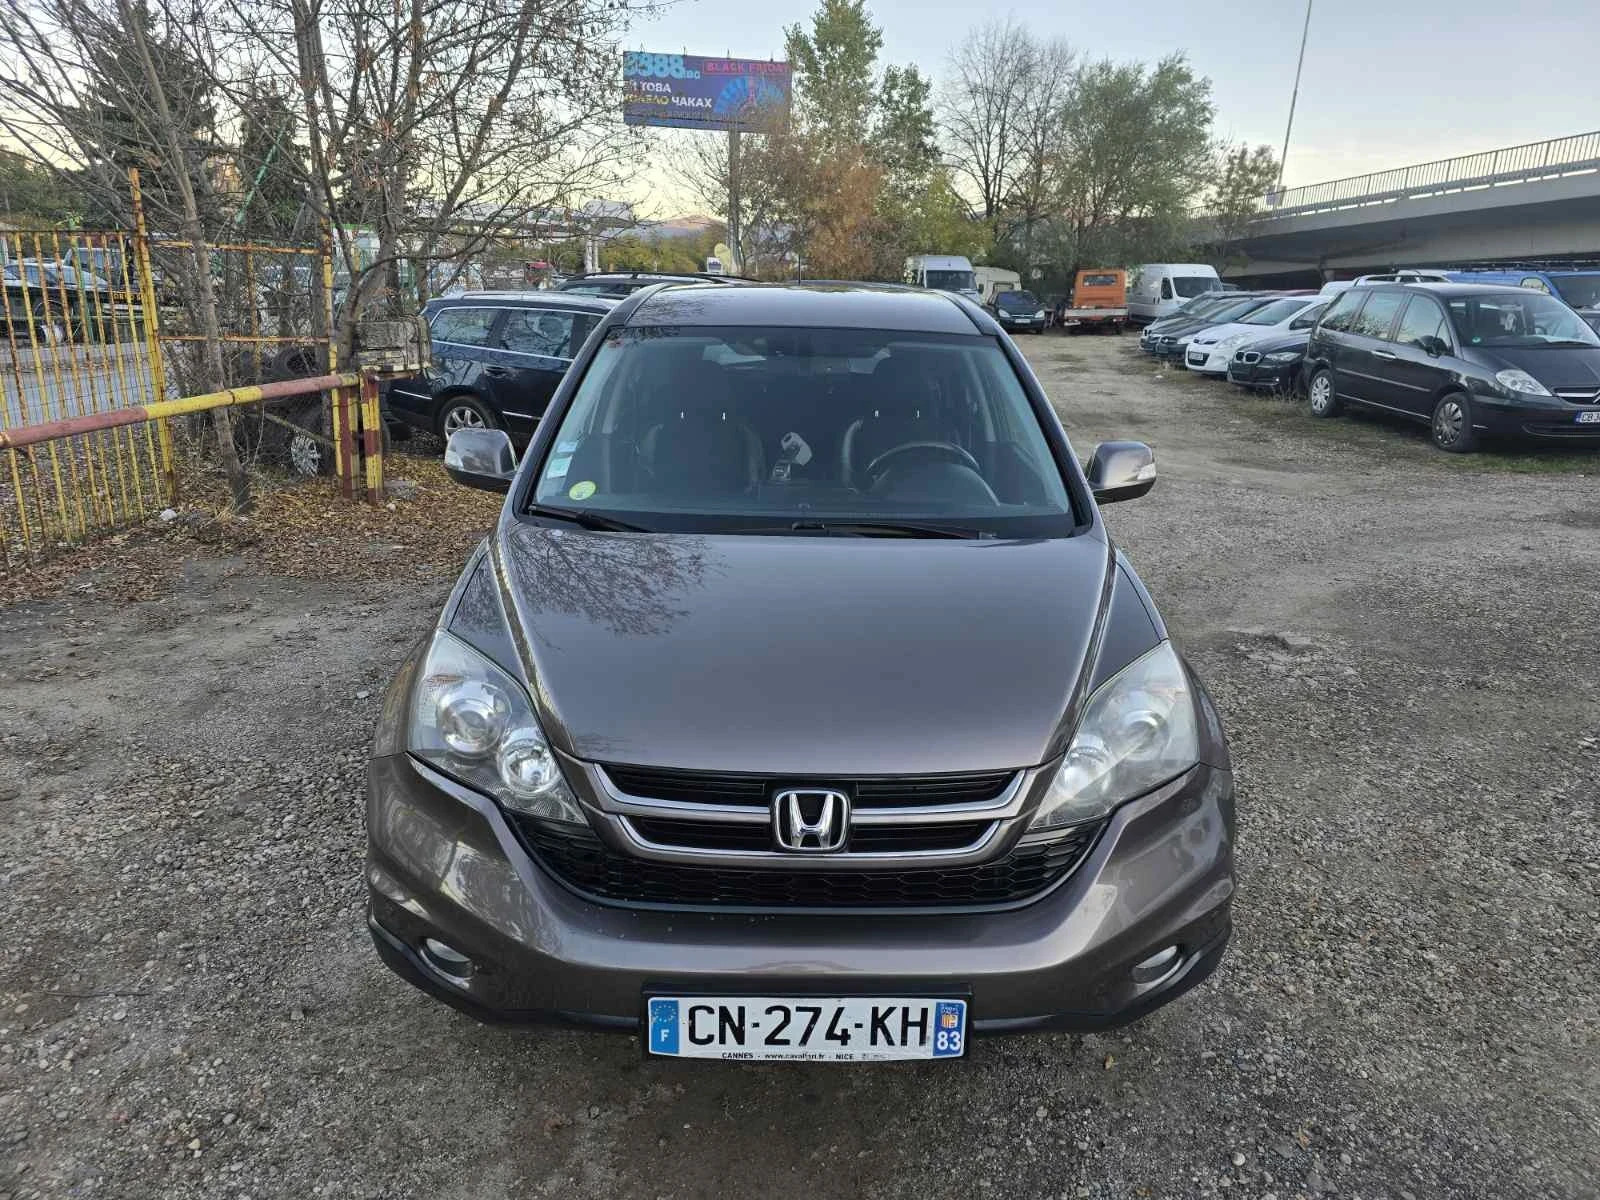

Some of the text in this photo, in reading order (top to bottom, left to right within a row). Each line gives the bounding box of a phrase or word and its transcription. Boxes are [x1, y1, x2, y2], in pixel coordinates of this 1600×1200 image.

[707, 62, 745, 73] BLACK
[641, 81, 672, 93] ТОВА
[671, 96, 712, 108] ЧАКАХ
[688, 1005, 929, 1047] CN-274-KH
[660, 1029, 668, 1042] F
[936, 1031, 961, 1051] 83
[722, 1052, 754, 1060] CANNES
